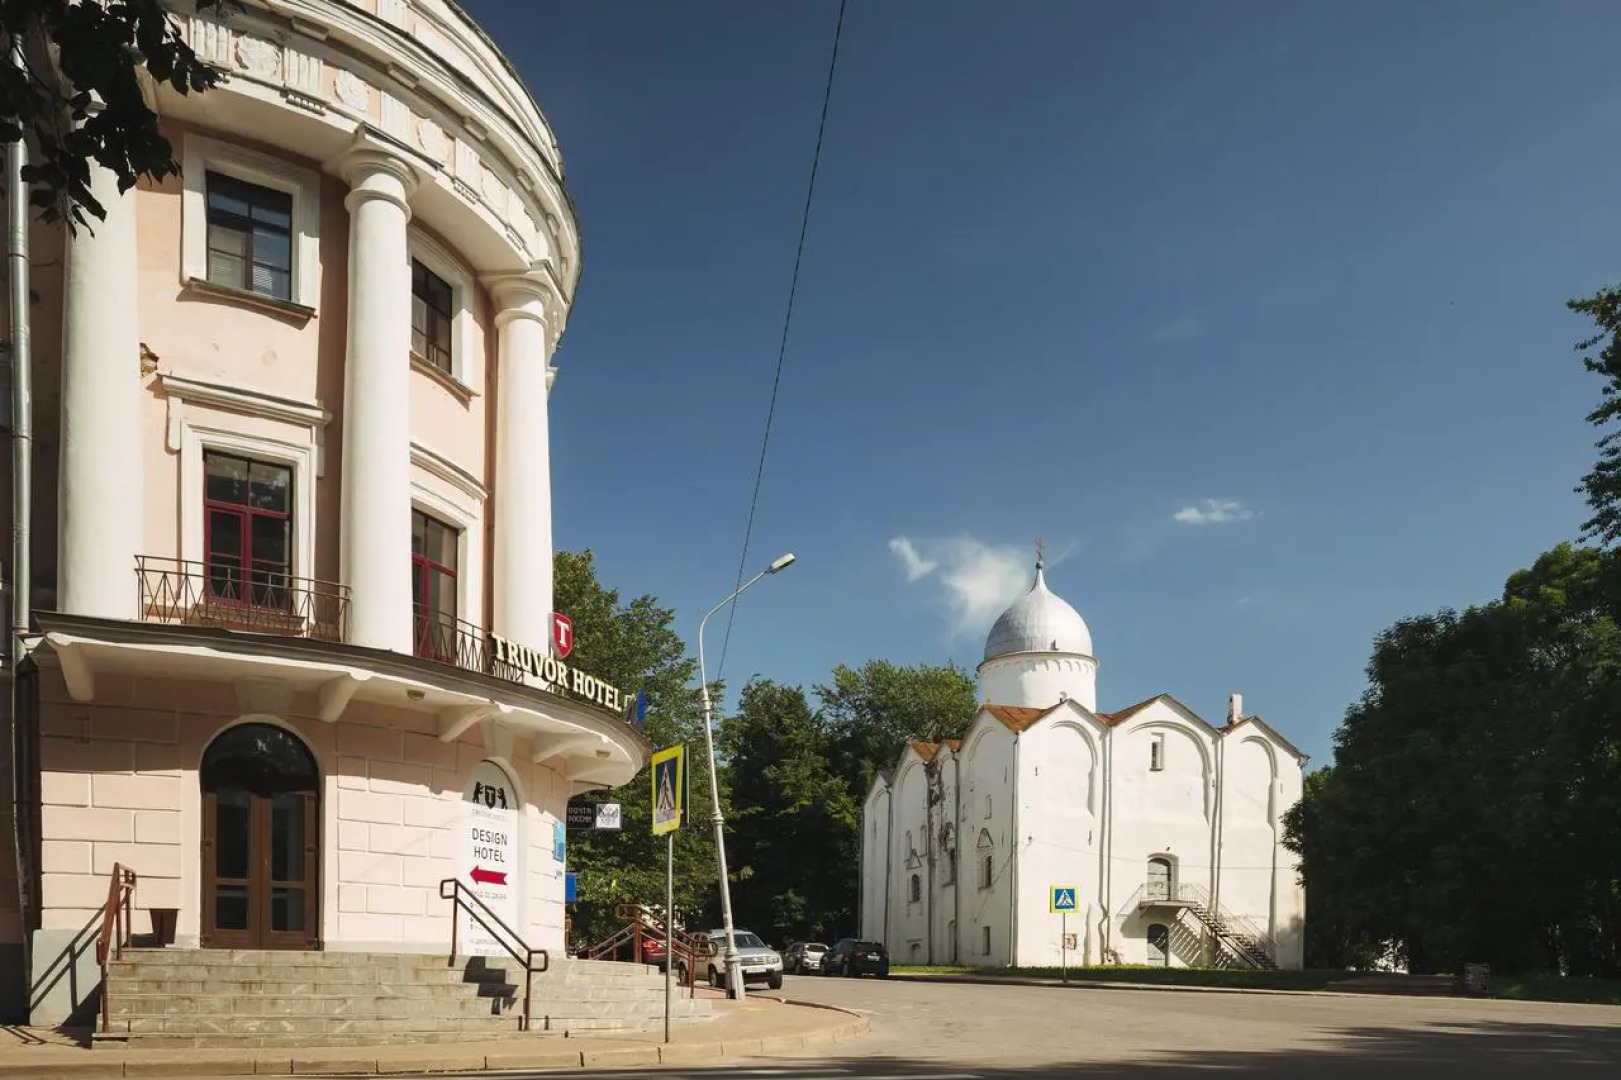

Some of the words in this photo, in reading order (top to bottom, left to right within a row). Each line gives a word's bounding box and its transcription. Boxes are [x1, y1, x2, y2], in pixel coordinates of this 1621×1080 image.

[556, 619, 570, 648] T
[491, 632, 569, 689] TRUVOR
[573, 667, 622, 712] HOTEL
[472, 828, 507, 846] DESIGN
[474, 846, 505, 863] HOTEL
